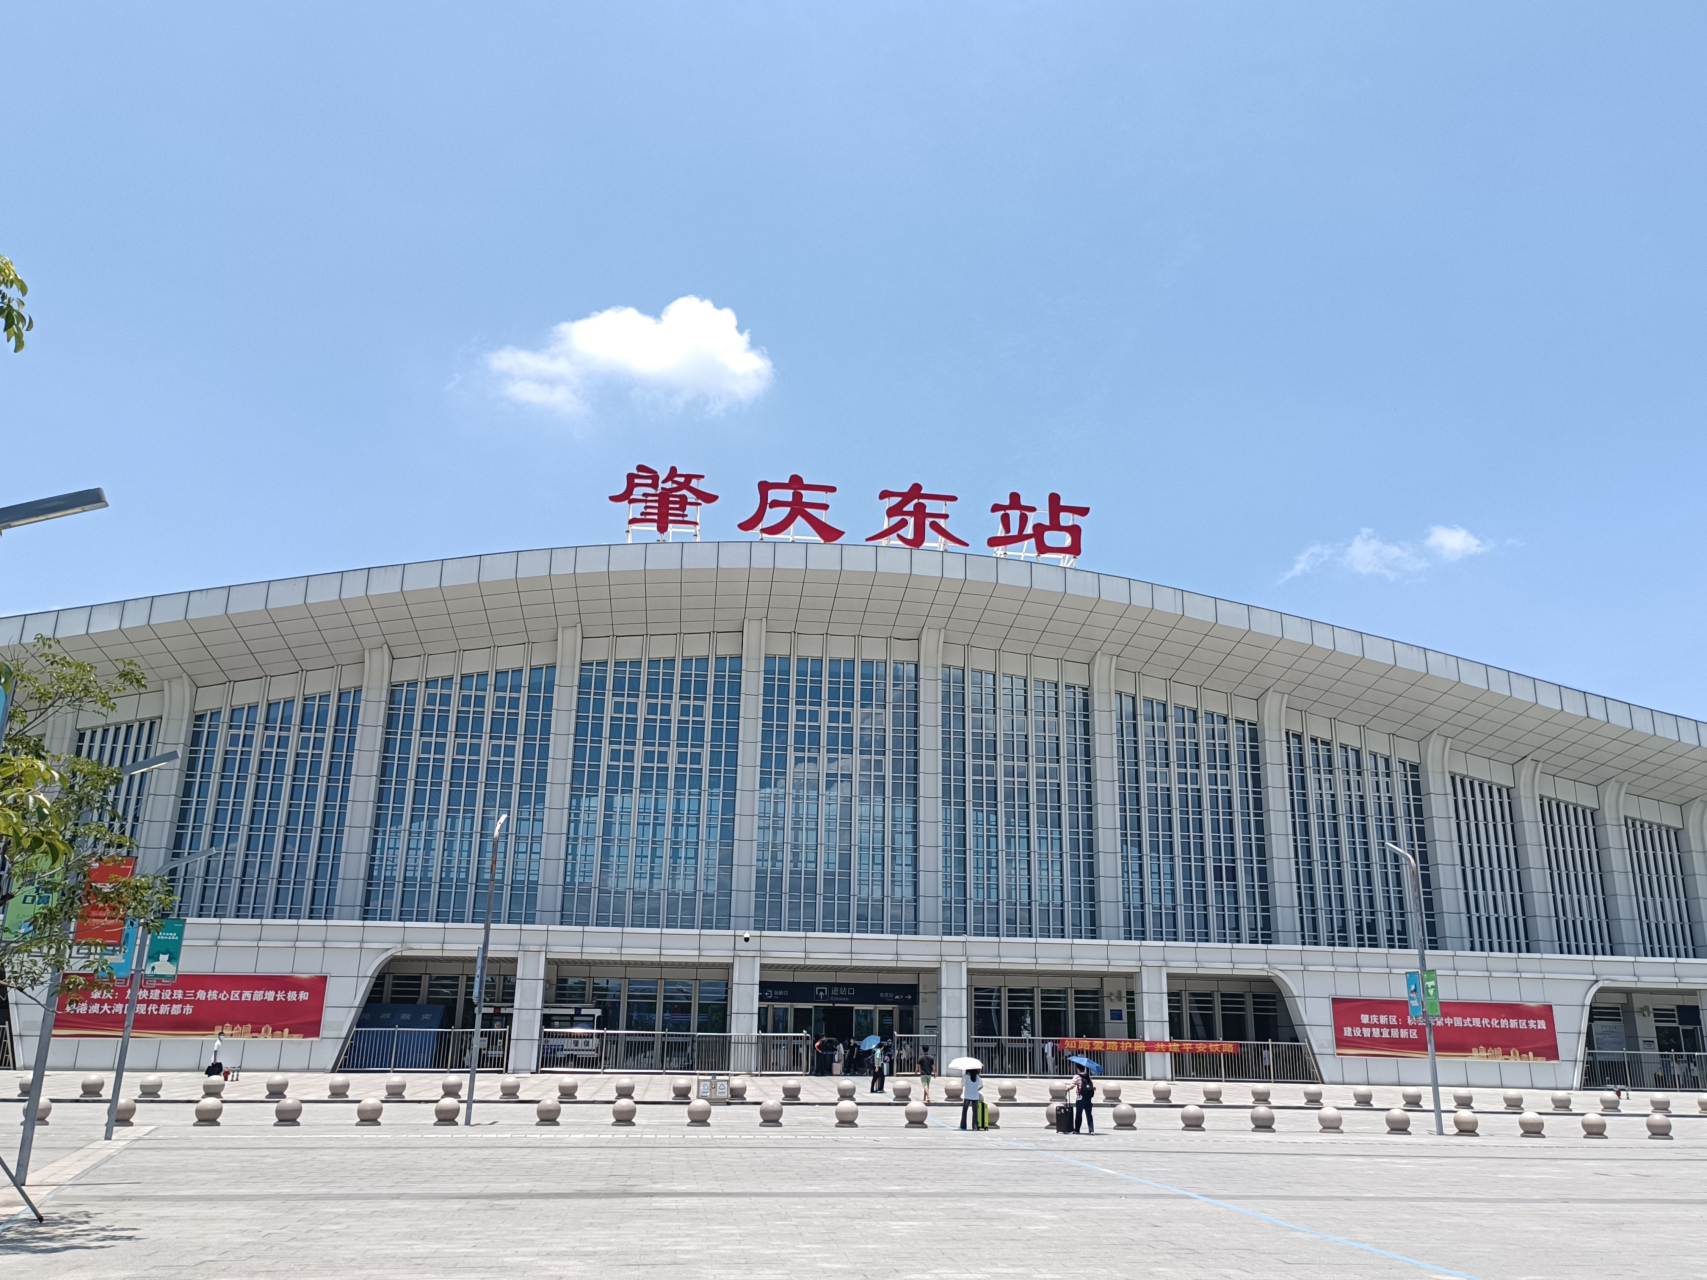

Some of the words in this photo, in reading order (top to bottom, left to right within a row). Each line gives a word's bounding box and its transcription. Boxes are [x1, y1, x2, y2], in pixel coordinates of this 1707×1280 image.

[609, 464, 1090, 556] 肇庆东站
[831, 986, 855, 996] 进站口
[1360, 1013, 1546, 1030] 肇庆新区：积索中国式现代化的新区实践
[1343, 1026, 1419, 1039] 建设智慧宜居新区
[1064, 1040, 1146, 1052] 知路爱路护路
[1155, 1042, 1234, 1053] 共建平安铁路
